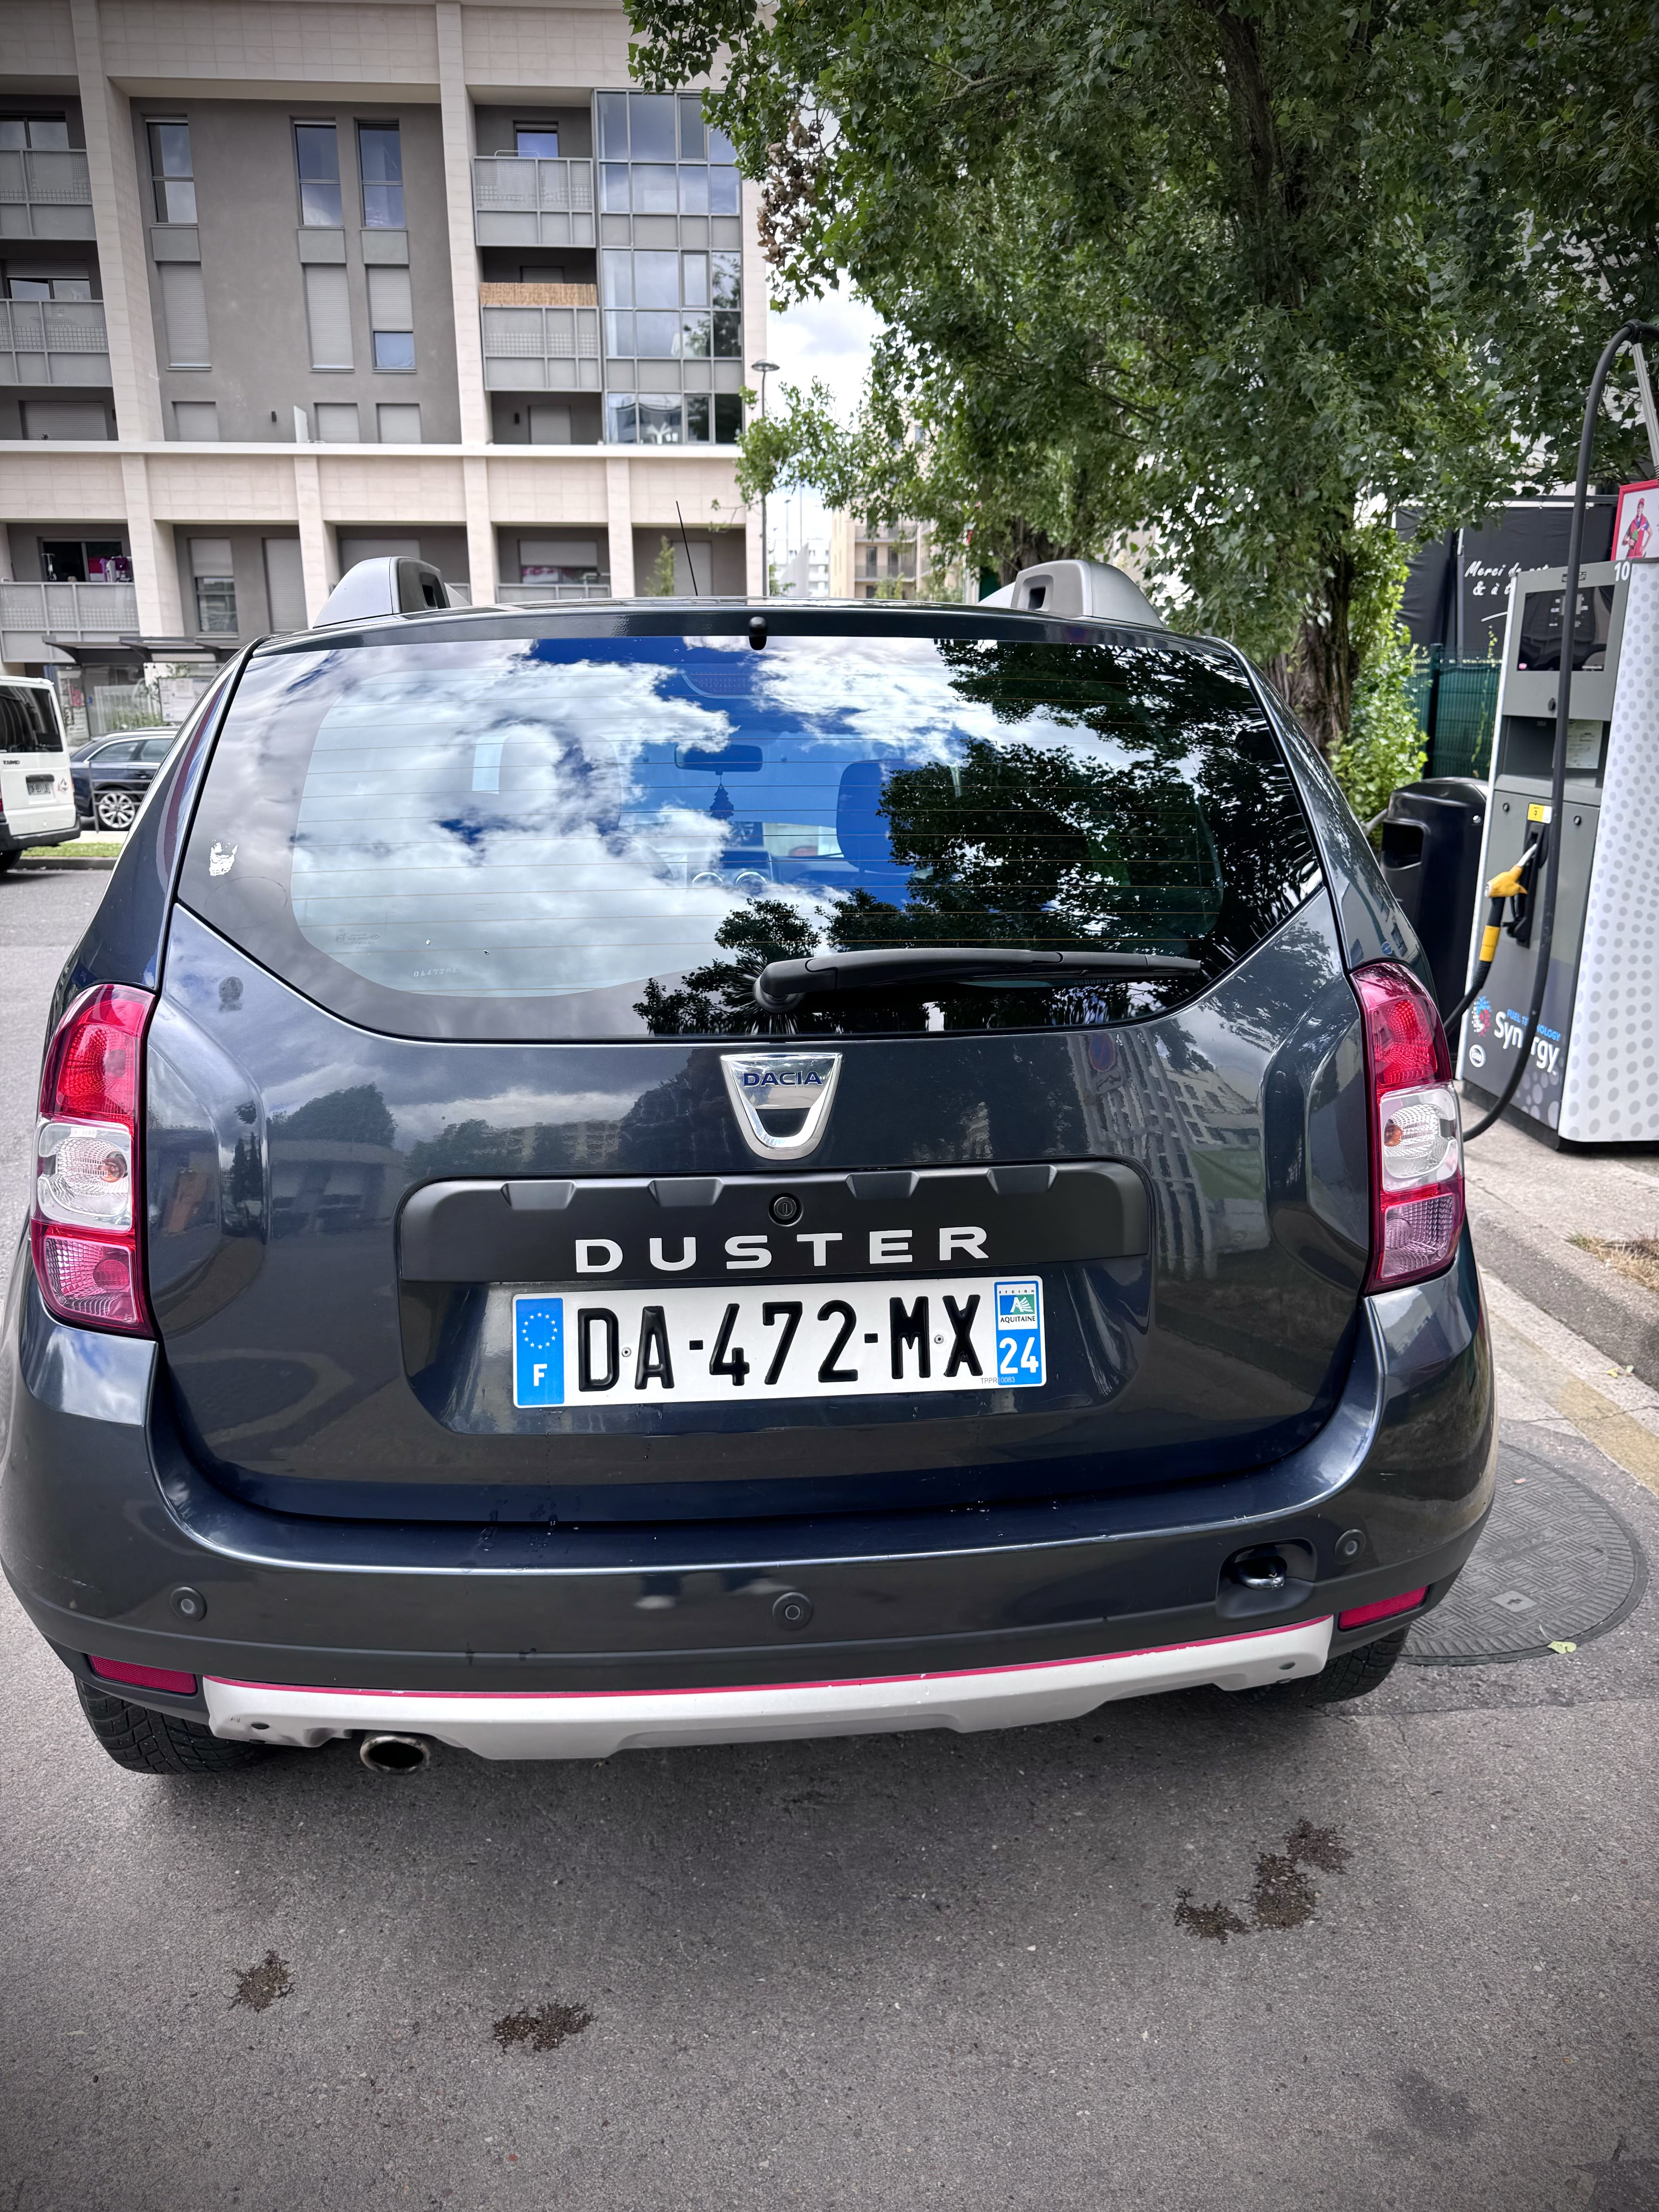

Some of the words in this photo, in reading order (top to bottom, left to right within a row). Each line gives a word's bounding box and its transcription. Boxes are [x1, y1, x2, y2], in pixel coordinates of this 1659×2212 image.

[1464, 560, 1506, 577] Merci
[1614, 561, 1630, 581] 10
[1473, 580, 1486, 596] &
[1507, 1009, 1521, 1023] FUEL
[1494, 1011, 1560, 1073] Synrgy
[743, 1071, 822, 1087] DACIA
[575, 1226, 989, 1273] DUSTER
[577, 1294, 984, 1392] DA-472-MX
[999, 1337, 1039, 1374] 24
[532, 1363, 548, 1386] F
